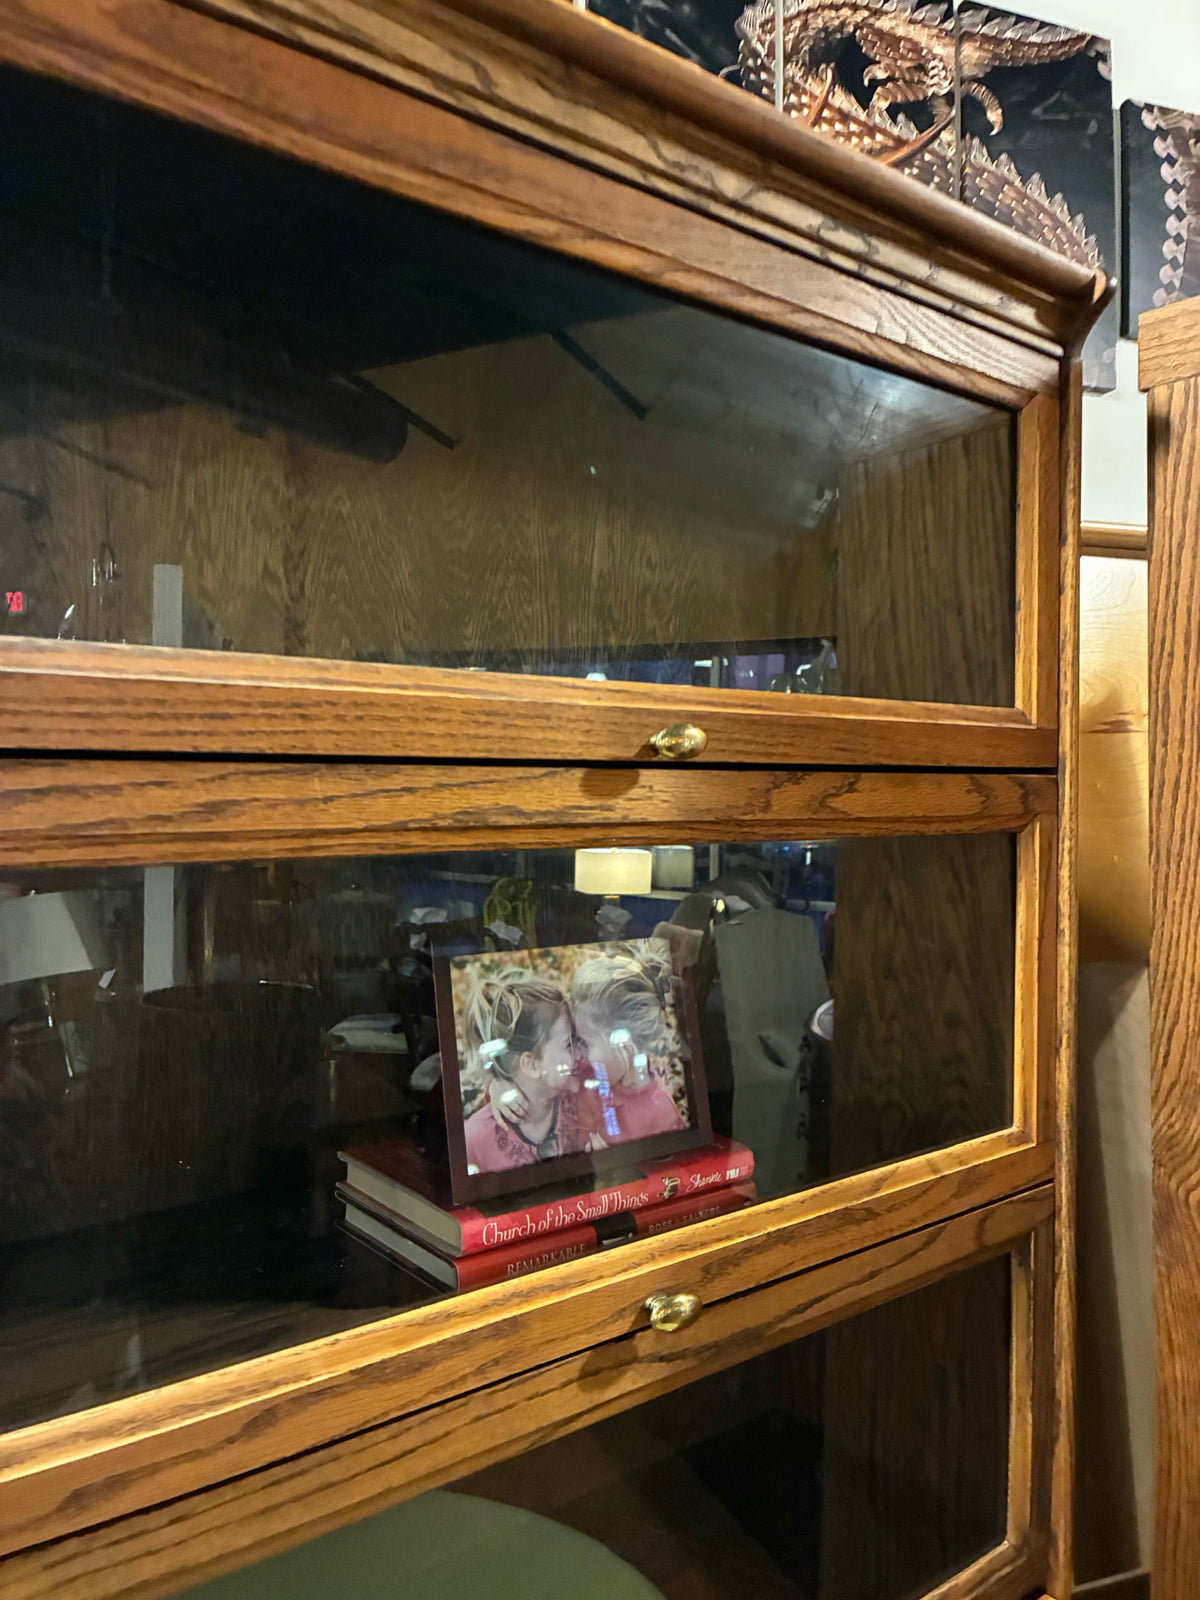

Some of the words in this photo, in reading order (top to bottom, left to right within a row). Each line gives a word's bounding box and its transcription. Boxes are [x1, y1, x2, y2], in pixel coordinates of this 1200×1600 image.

[483, 1214, 535, 1246] Church
[538, 1208, 554, 1231] of
[555, 1206, 575, 1227] the
[577, 1194, 608, 1221] Small
[609, 1191, 648, 1211] Things
[507, 1243, 585, 1276] REMARKABLE
